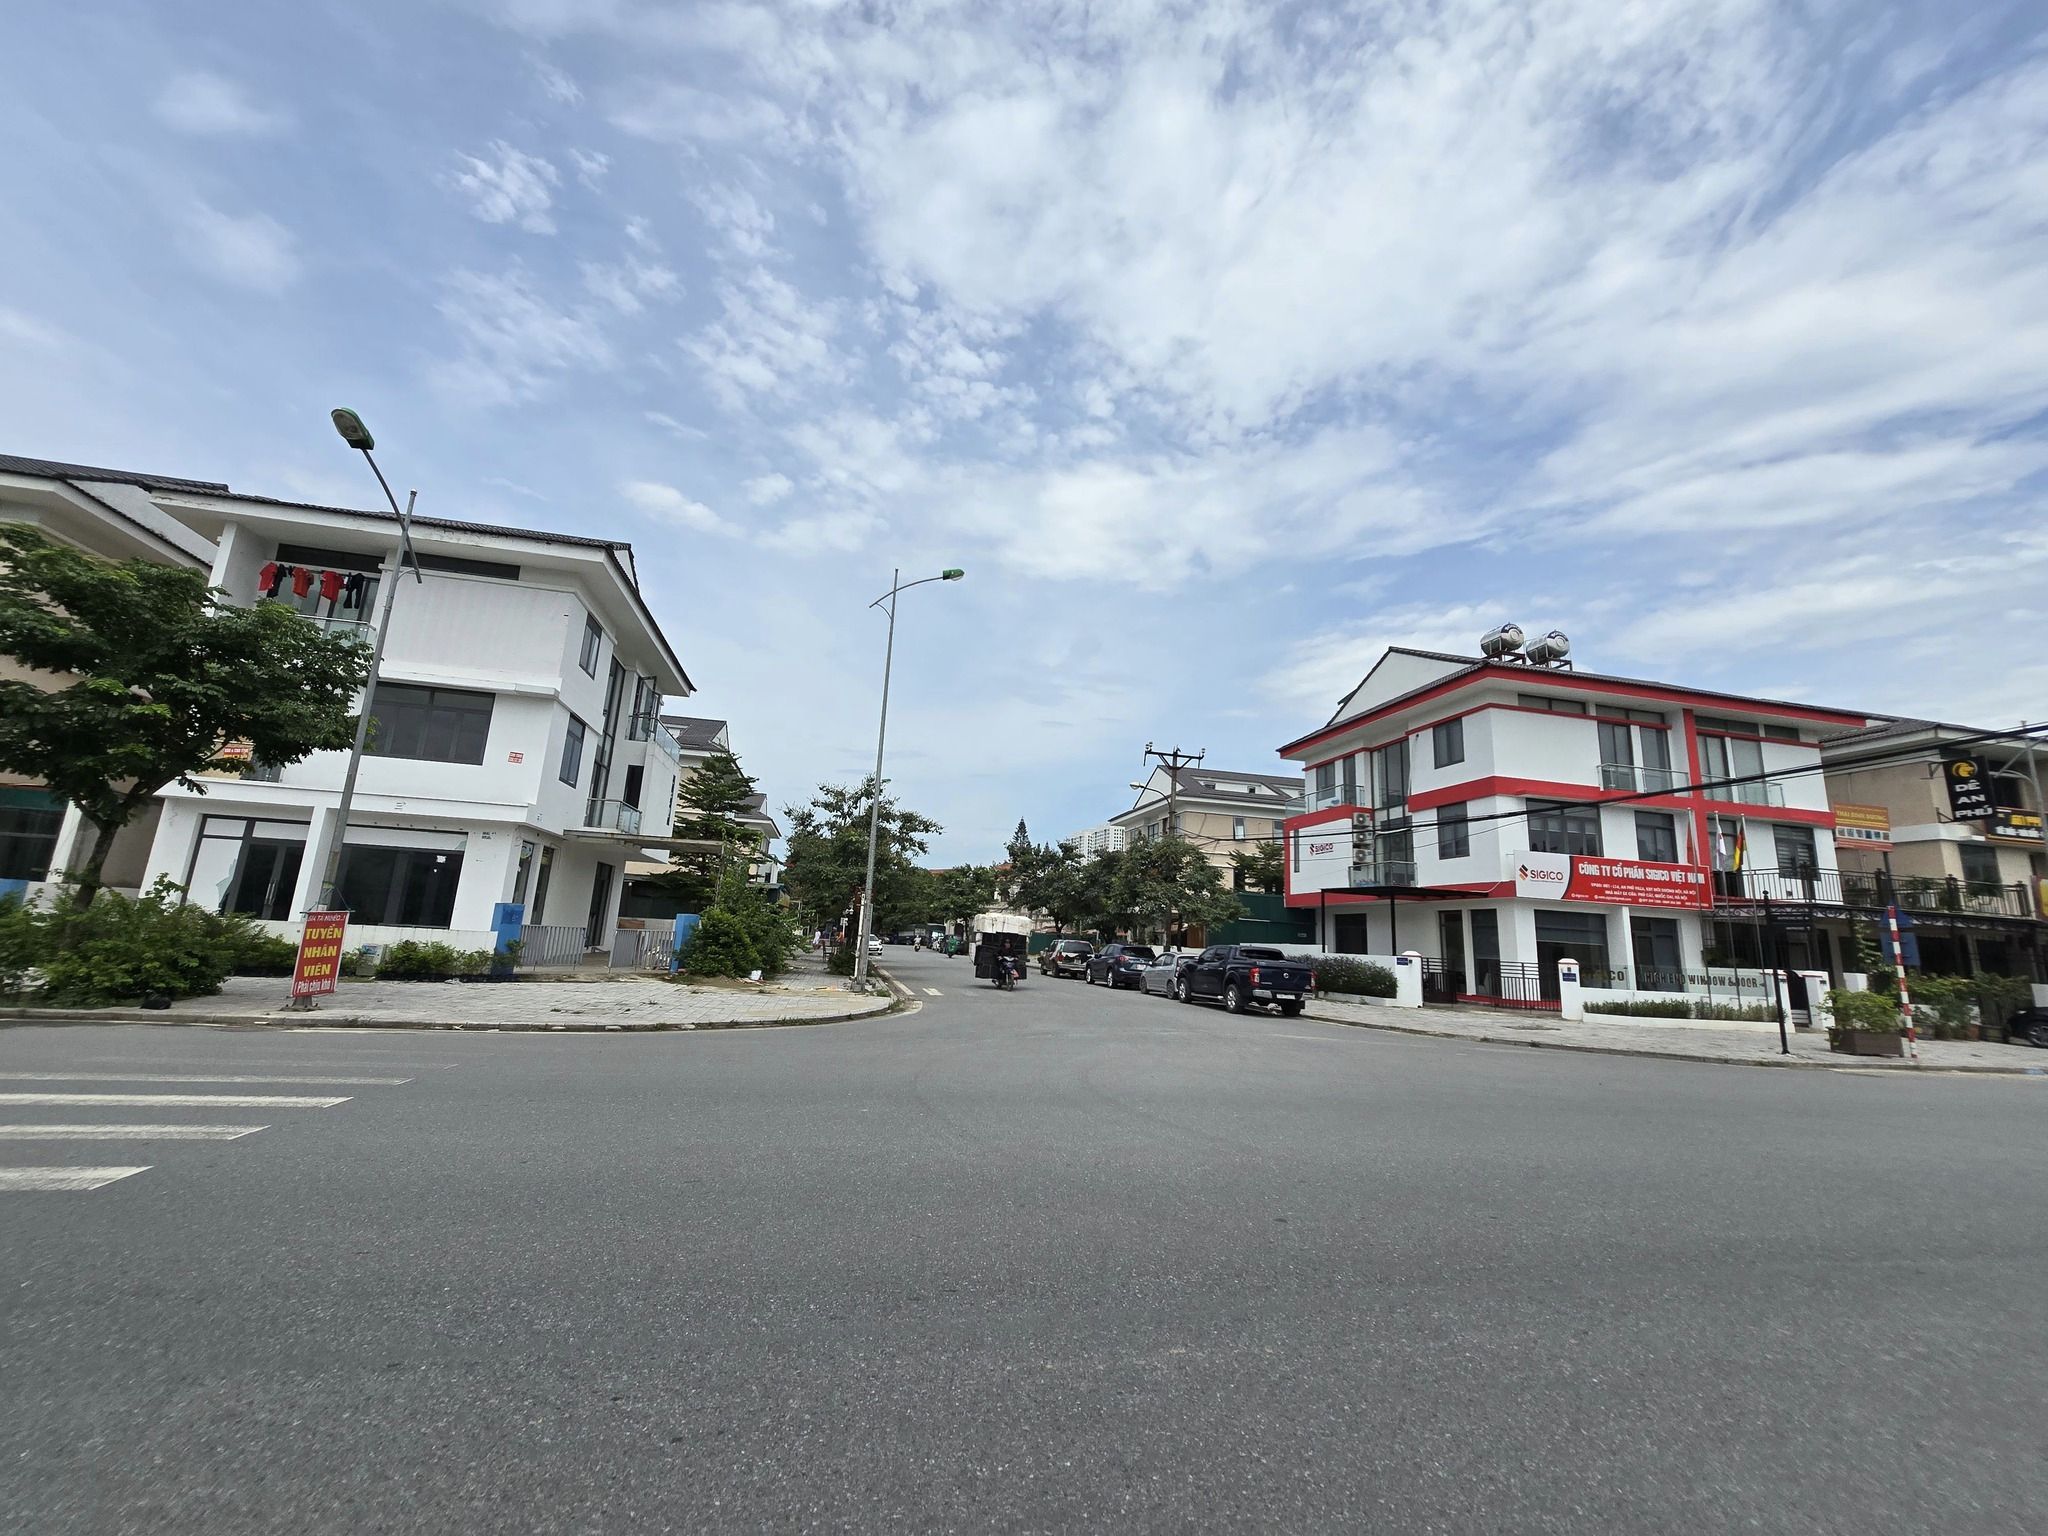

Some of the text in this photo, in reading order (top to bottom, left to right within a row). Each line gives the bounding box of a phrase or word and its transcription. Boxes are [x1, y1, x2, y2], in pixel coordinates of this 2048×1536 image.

[1955, 779, 1981, 792] DÊ
[1957, 794, 1986, 804] AN
[1955, 805, 1993, 818] PHÚ
[1315, 843, 1334, 852] SIGICO
[1530, 869, 1564, 881] SIGICO
[1578, 861, 1705, 884] CÔNG TY CỔ PHẦN SIGICO VIỆT NAM
[305, 924, 343, 940] TUYỂN
[303, 944, 337, 958] NHÂN
[303, 963, 331, 977] VIÊN
[1644, 971, 1665, 984] HIGH
[1667, 973, 1686, 985] END
[1728, 977, 1736, 987] &
